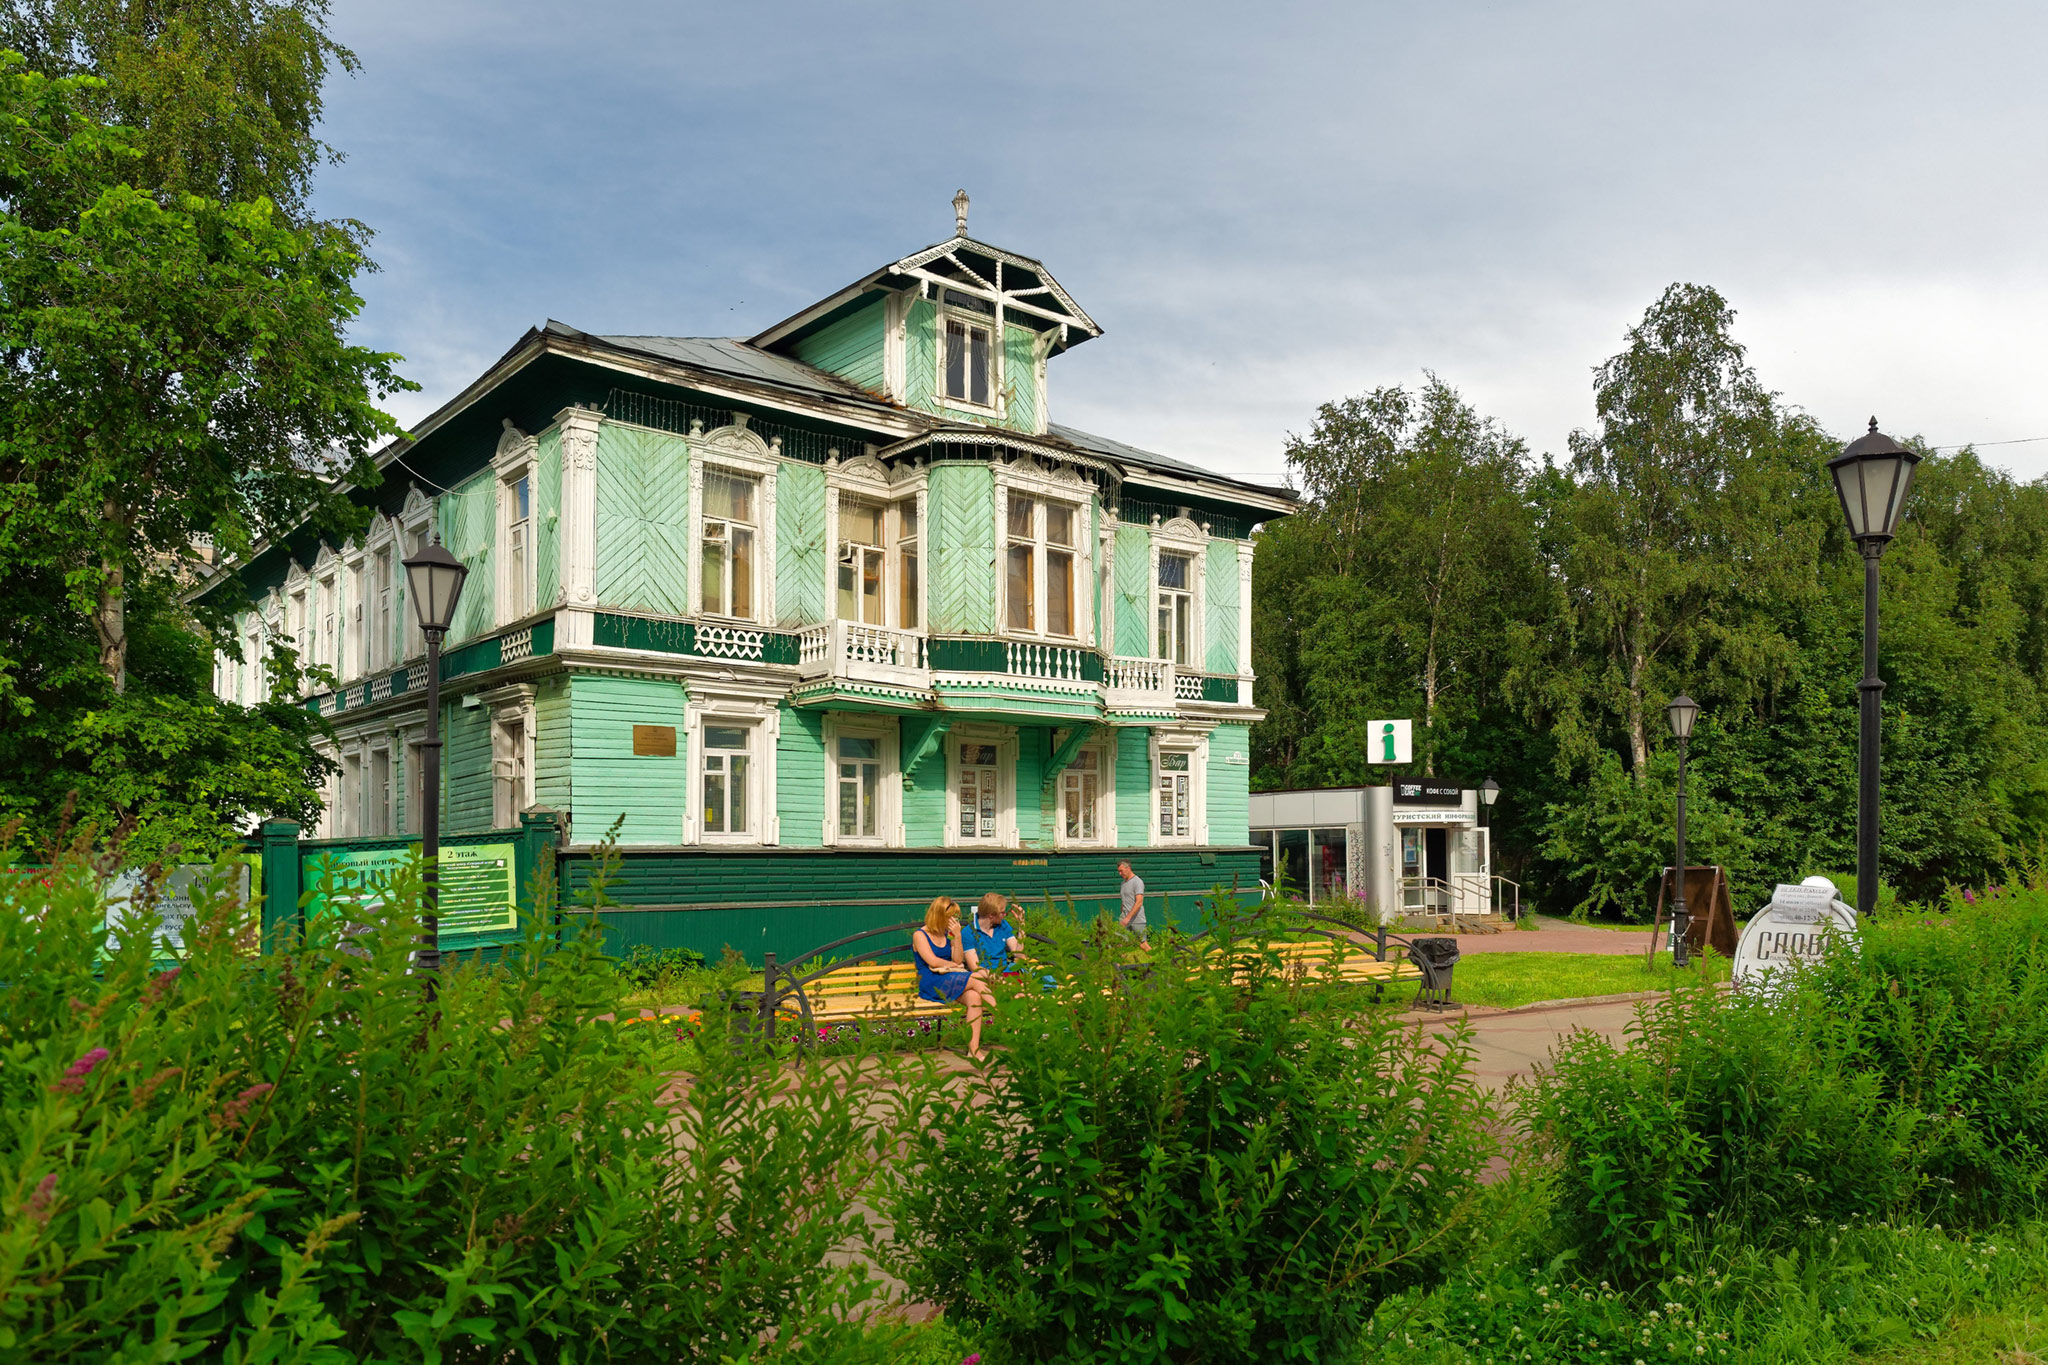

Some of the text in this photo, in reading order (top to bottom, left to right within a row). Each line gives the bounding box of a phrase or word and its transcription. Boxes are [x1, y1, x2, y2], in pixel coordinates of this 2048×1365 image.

[1160, 754, 1187, 771] Бар
[1443, 787, 1459, 796] СОБОЙ
[447, 850, 478, 859] 2 этаж
